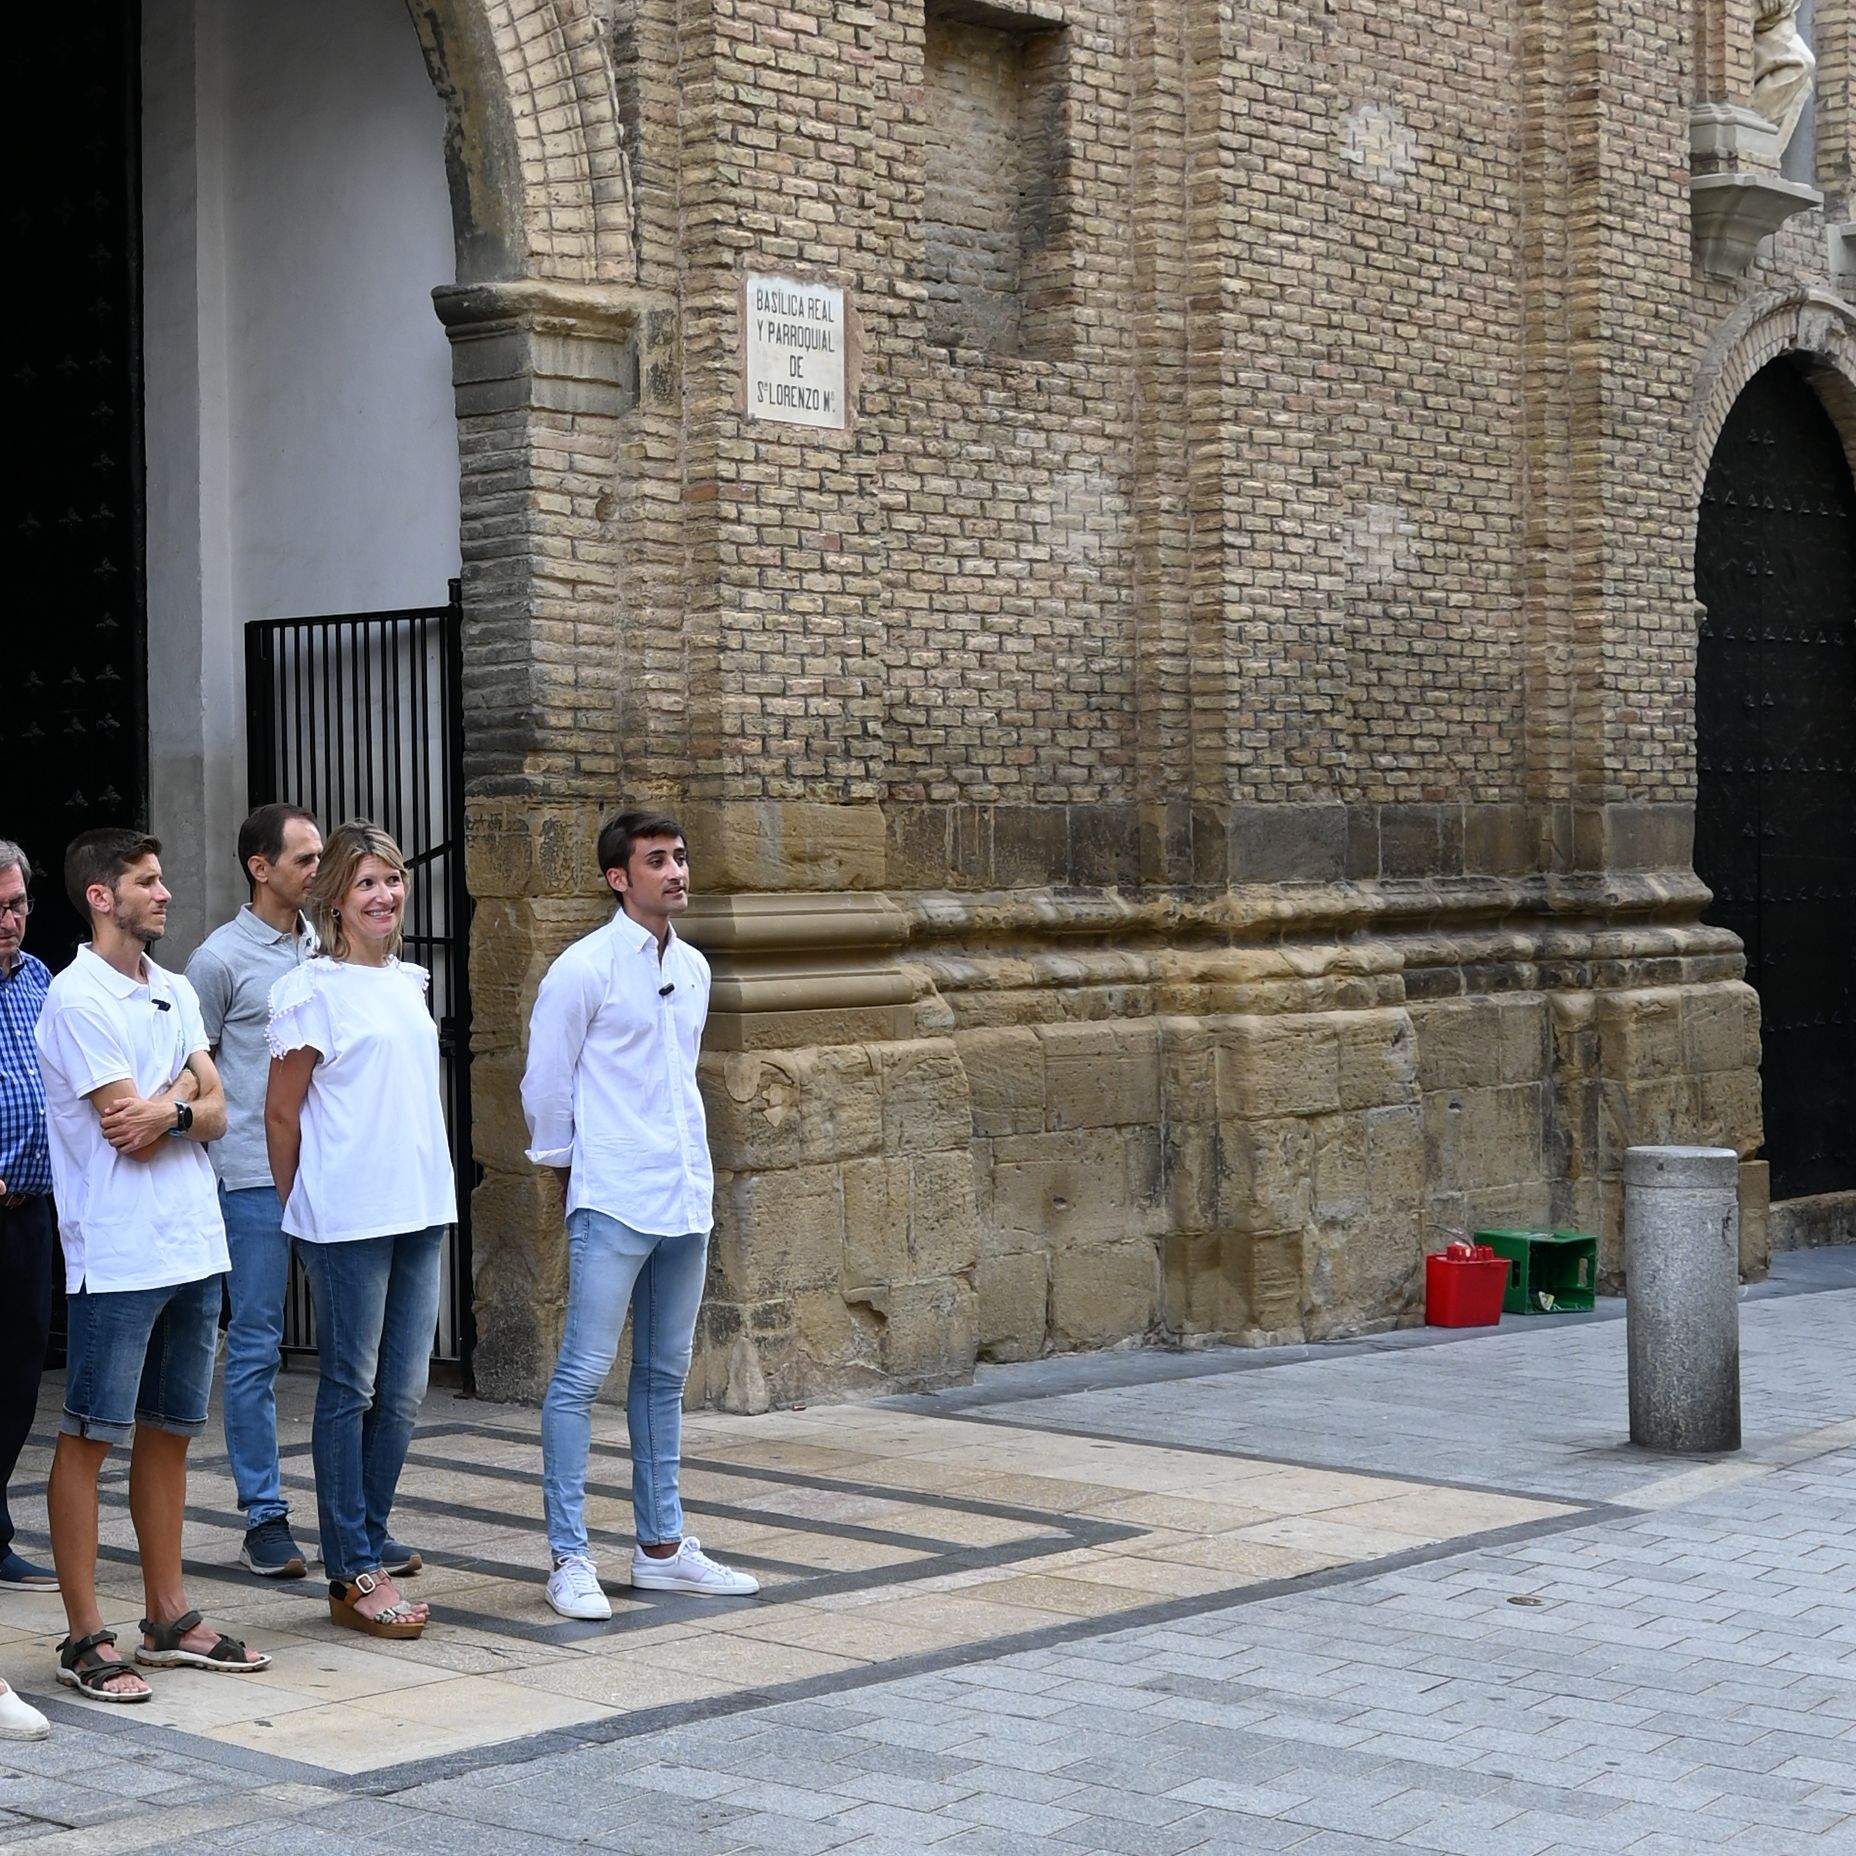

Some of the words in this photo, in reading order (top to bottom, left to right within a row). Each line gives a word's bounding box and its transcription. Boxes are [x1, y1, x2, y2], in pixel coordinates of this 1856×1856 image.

[808, 297, 834, 322] REAL
[757, 320, 763, 341] Y
[768, 321, 835, 352] PARROQUIAL
[789, 355, 804, 378] DE
